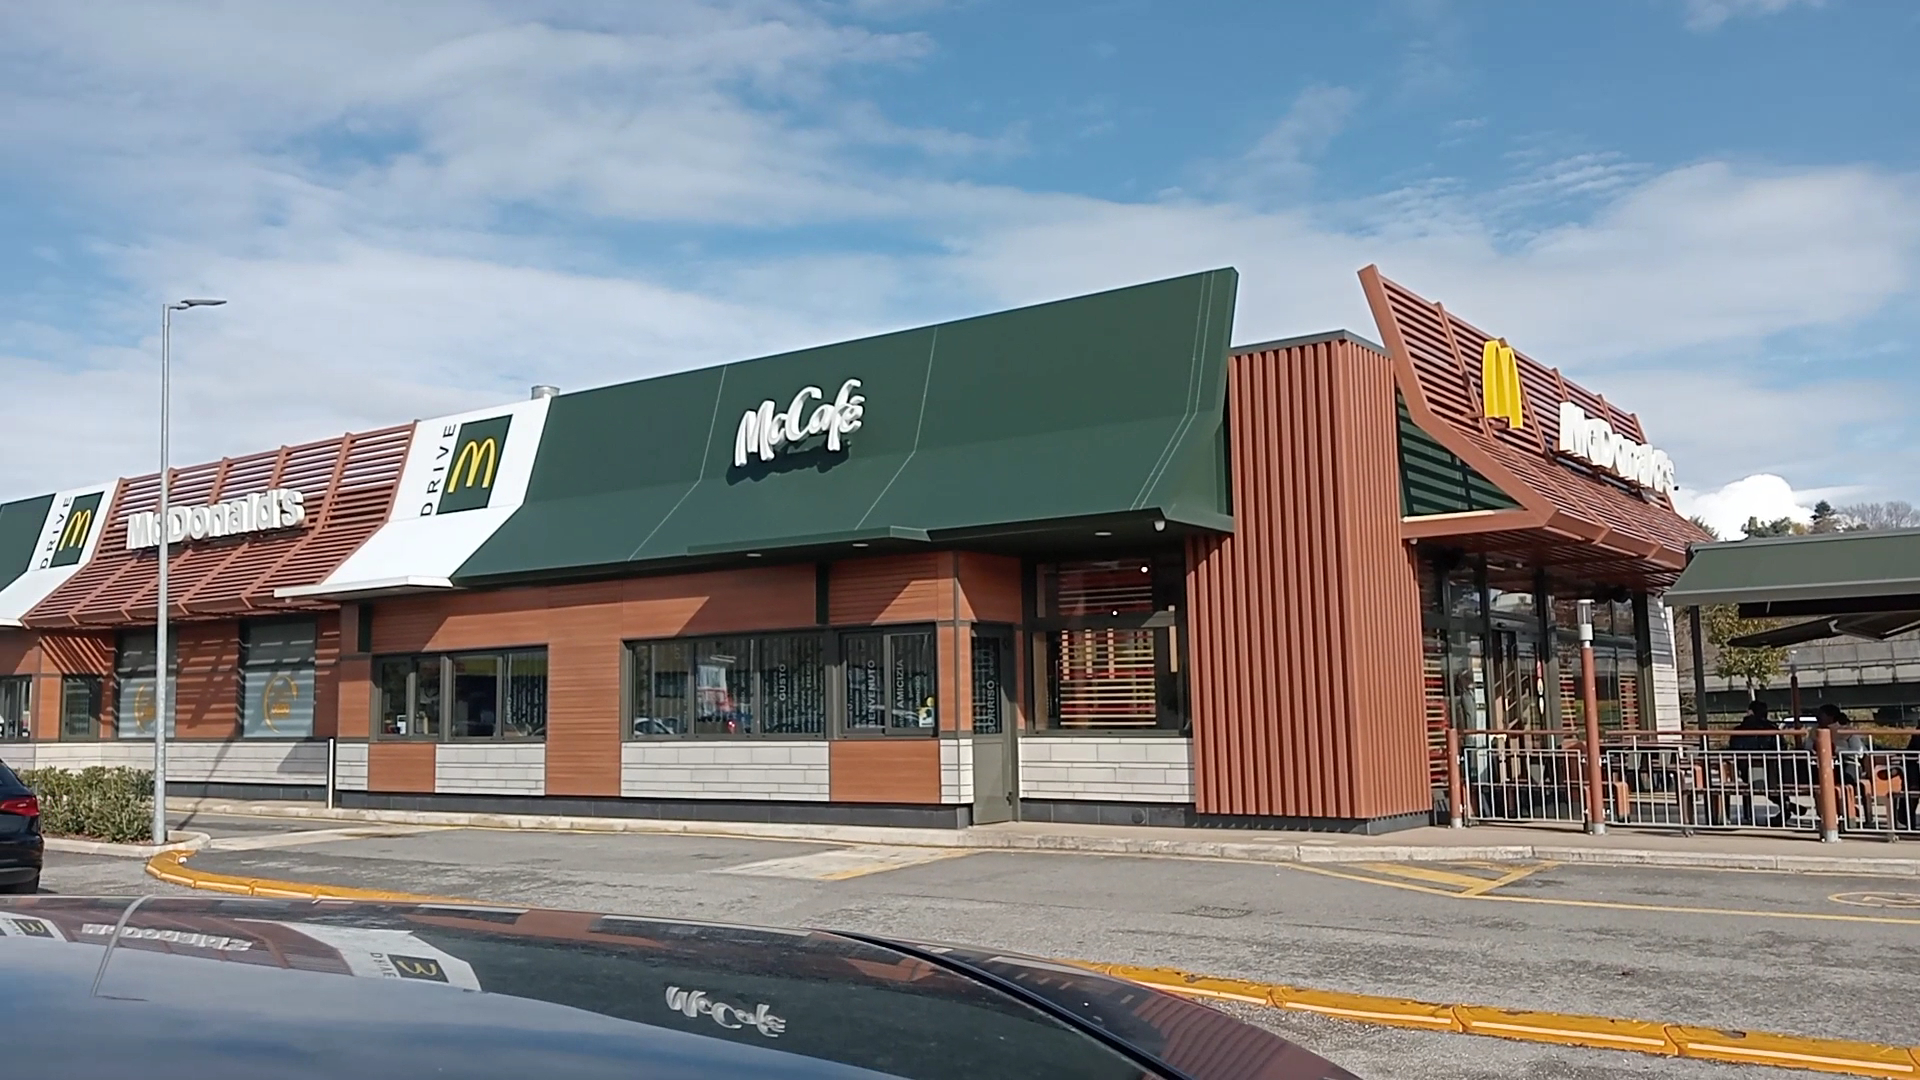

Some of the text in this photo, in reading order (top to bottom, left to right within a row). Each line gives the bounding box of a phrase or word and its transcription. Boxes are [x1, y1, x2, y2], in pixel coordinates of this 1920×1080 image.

[734, 377, 866, 468] McCafé
[420, 424, 456, 517] DRIVE
[40, 497, 72, 569] DRIVE
[126, 487, 306, 551] McDonald's
[778, 663, 787, 701] GUSTO
[867, 660, 876, 728] BENVENUTO
[896, 659, 905, 709] AMICIZIA
[986, 680, 996, 734] SORRISO
